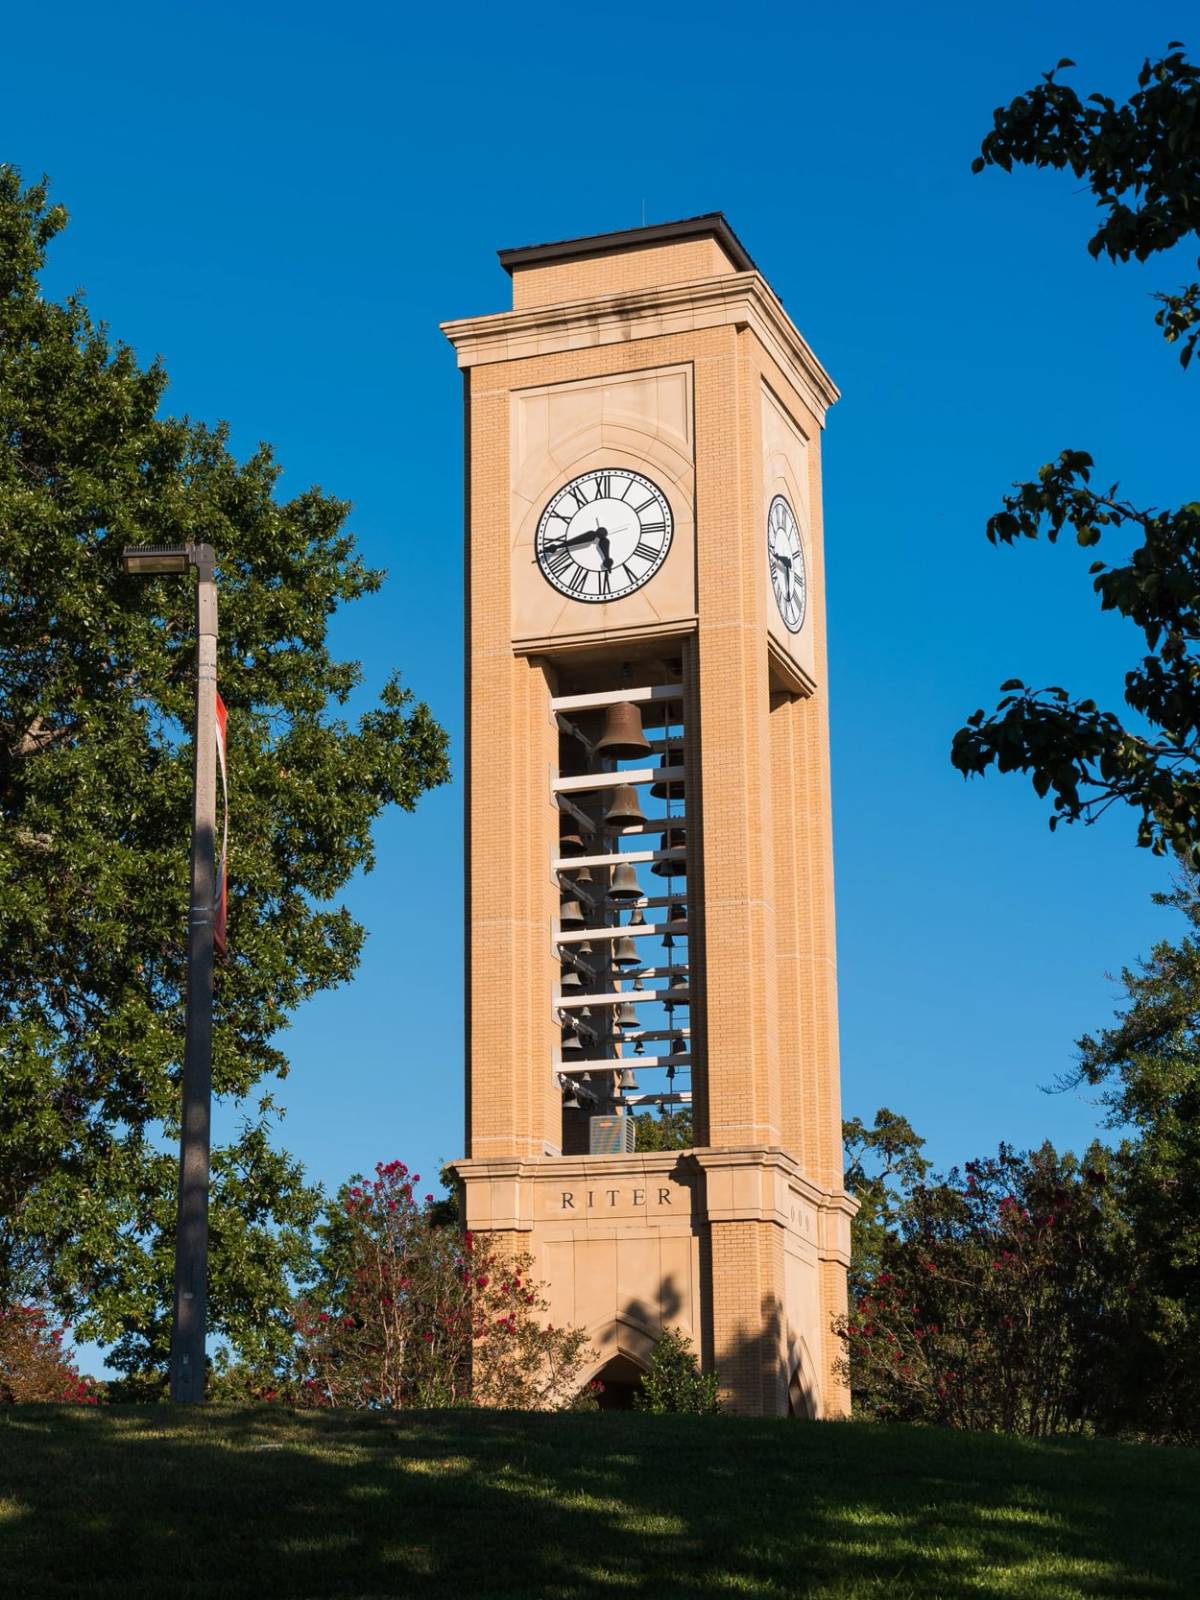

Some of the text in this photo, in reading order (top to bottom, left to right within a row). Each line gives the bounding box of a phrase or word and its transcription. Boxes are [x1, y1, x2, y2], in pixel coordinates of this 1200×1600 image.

[569, 485, 589, 510] XI
[595, 476, 611, 499] XII
[621, 480, 634, 501] I
[635, 496, 657, 513] II
[550, 510, 572, 525] X
[641, 522, 665, 534] III
[633, 542, 660, 563] IIII
[548, 550, 574, 579] VIII
[622, 563, 639, 585] V
[569, 566, 589, 593] VII
[598, 571, 611, 595] VI
[561, 1187, 673, 1209] RITER
